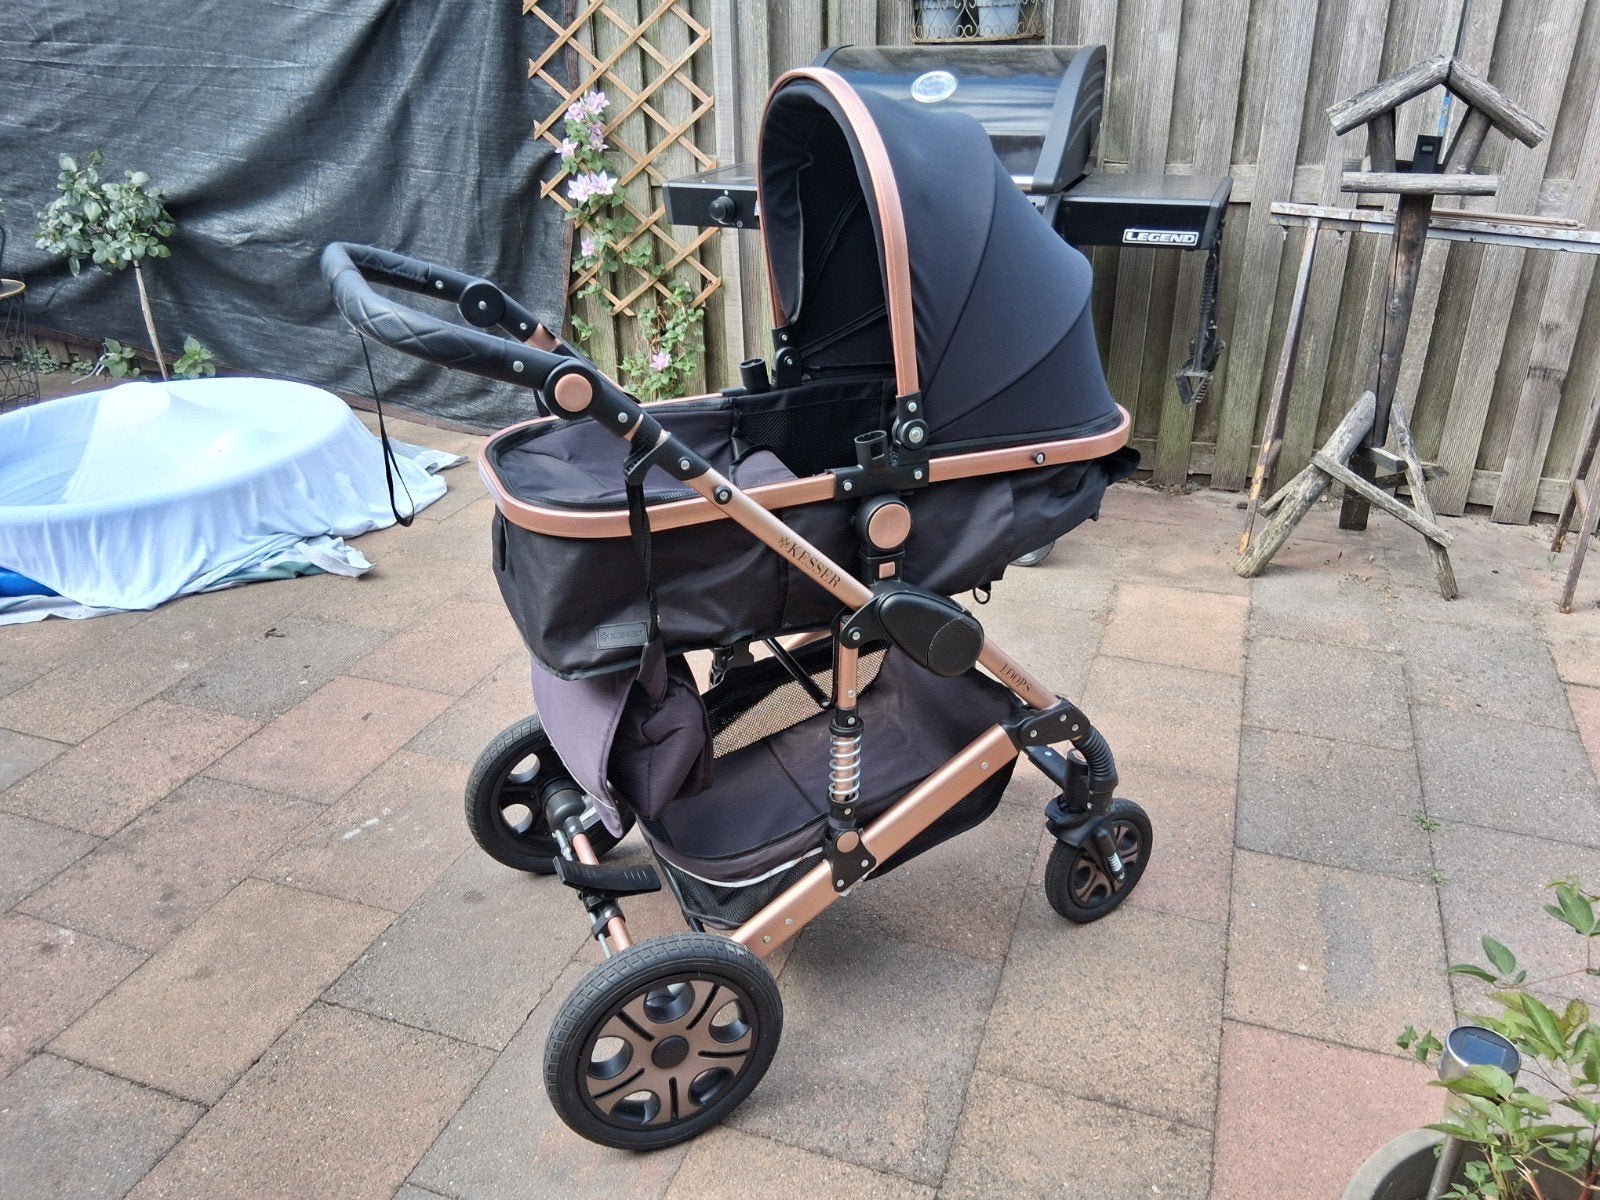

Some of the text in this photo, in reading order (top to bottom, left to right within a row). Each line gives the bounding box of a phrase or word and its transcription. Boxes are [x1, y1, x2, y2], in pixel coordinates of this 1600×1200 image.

[1126, 232, 1195, 243] LEGEND
[787, 543, 840, 588] KESSER
[1000, 663, 1032, 692] LOOPS
